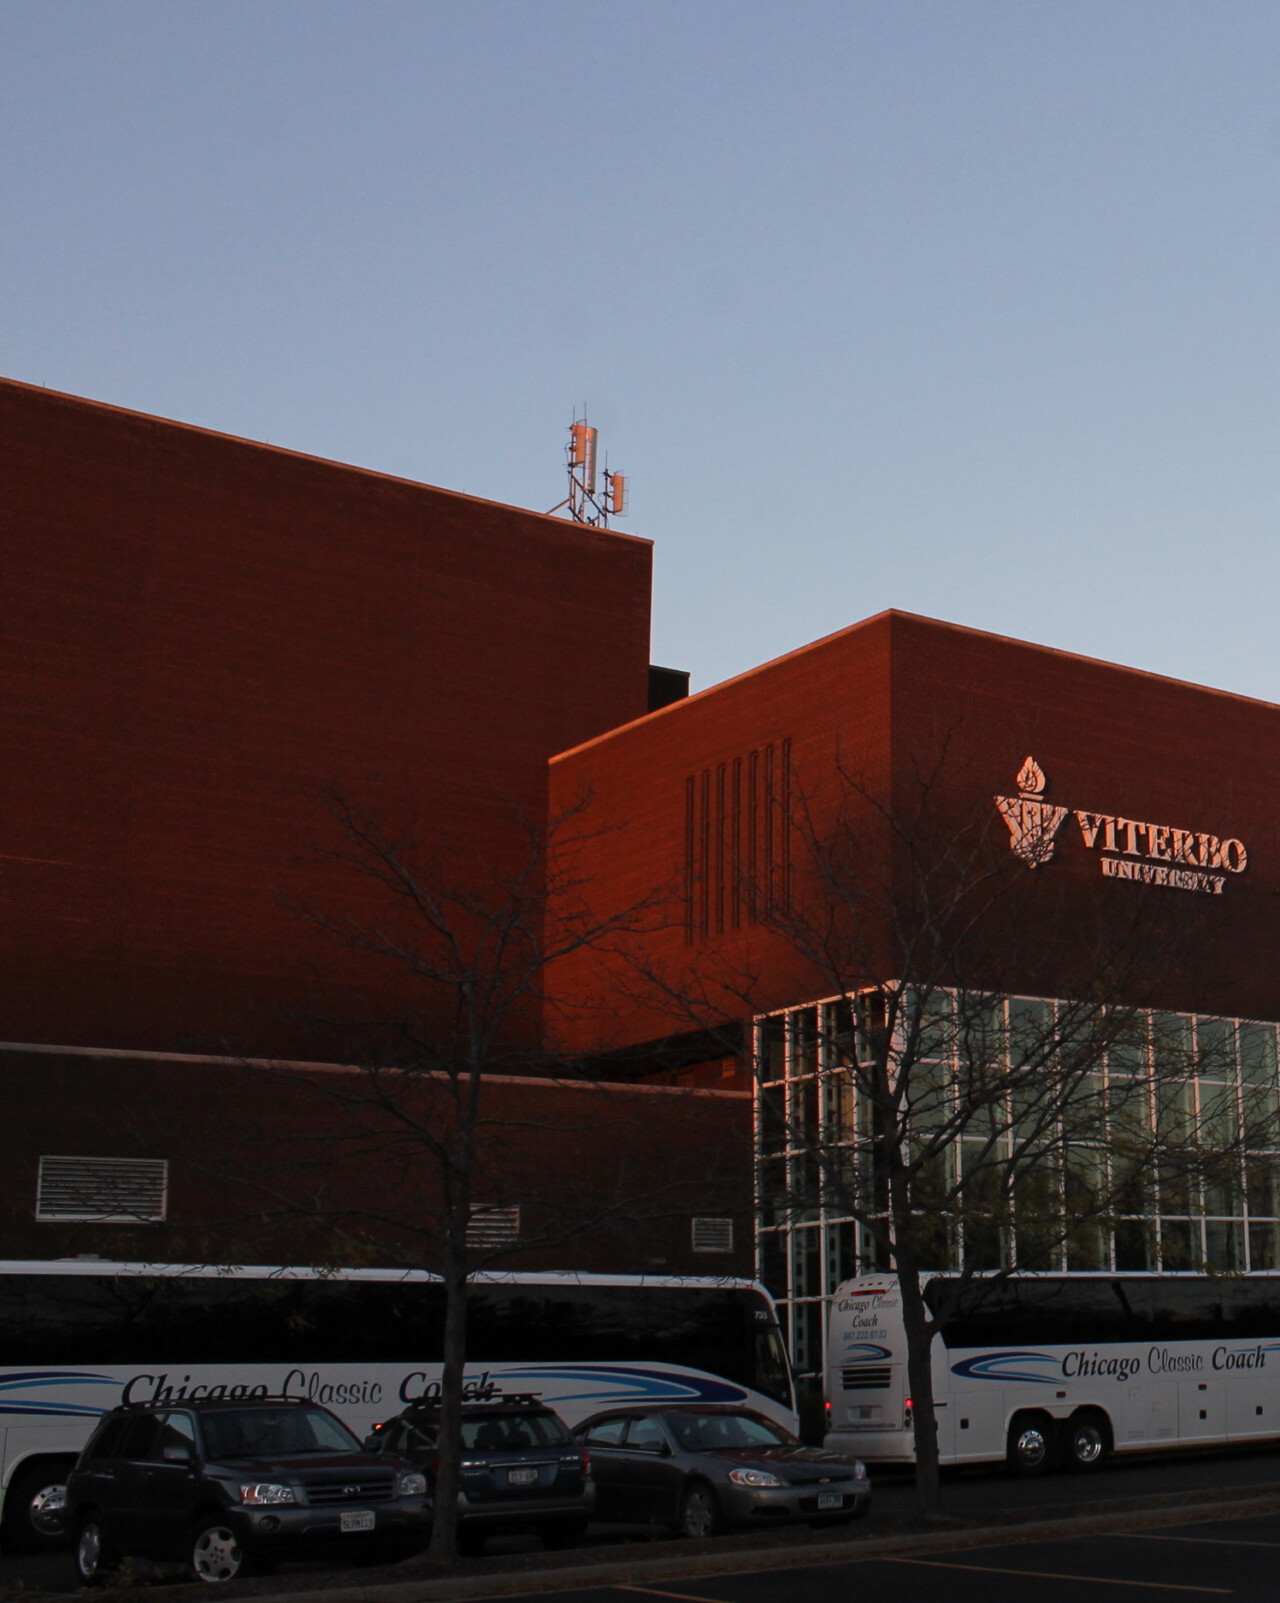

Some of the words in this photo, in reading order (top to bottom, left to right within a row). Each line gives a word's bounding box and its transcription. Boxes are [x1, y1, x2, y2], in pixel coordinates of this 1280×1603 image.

[1073, 809, 1248, 874] VITERBO
[1100, 857, 1227, 895] UNIVERSITY
[838, 1299, 870, 1313] Chicago
[852, 1314, 878, 1328] Coach
[1062, 1352, 1140, 1381] Chicago
[1148, 1346, 1203, 1374] Classic
[1212, 1345, 1265, 1370] Coach
[122, 1374, 268, 1406] Chicago
[282, 1369, 382, 1404] Classic
[399, 1371, 496, 1404] Coch
